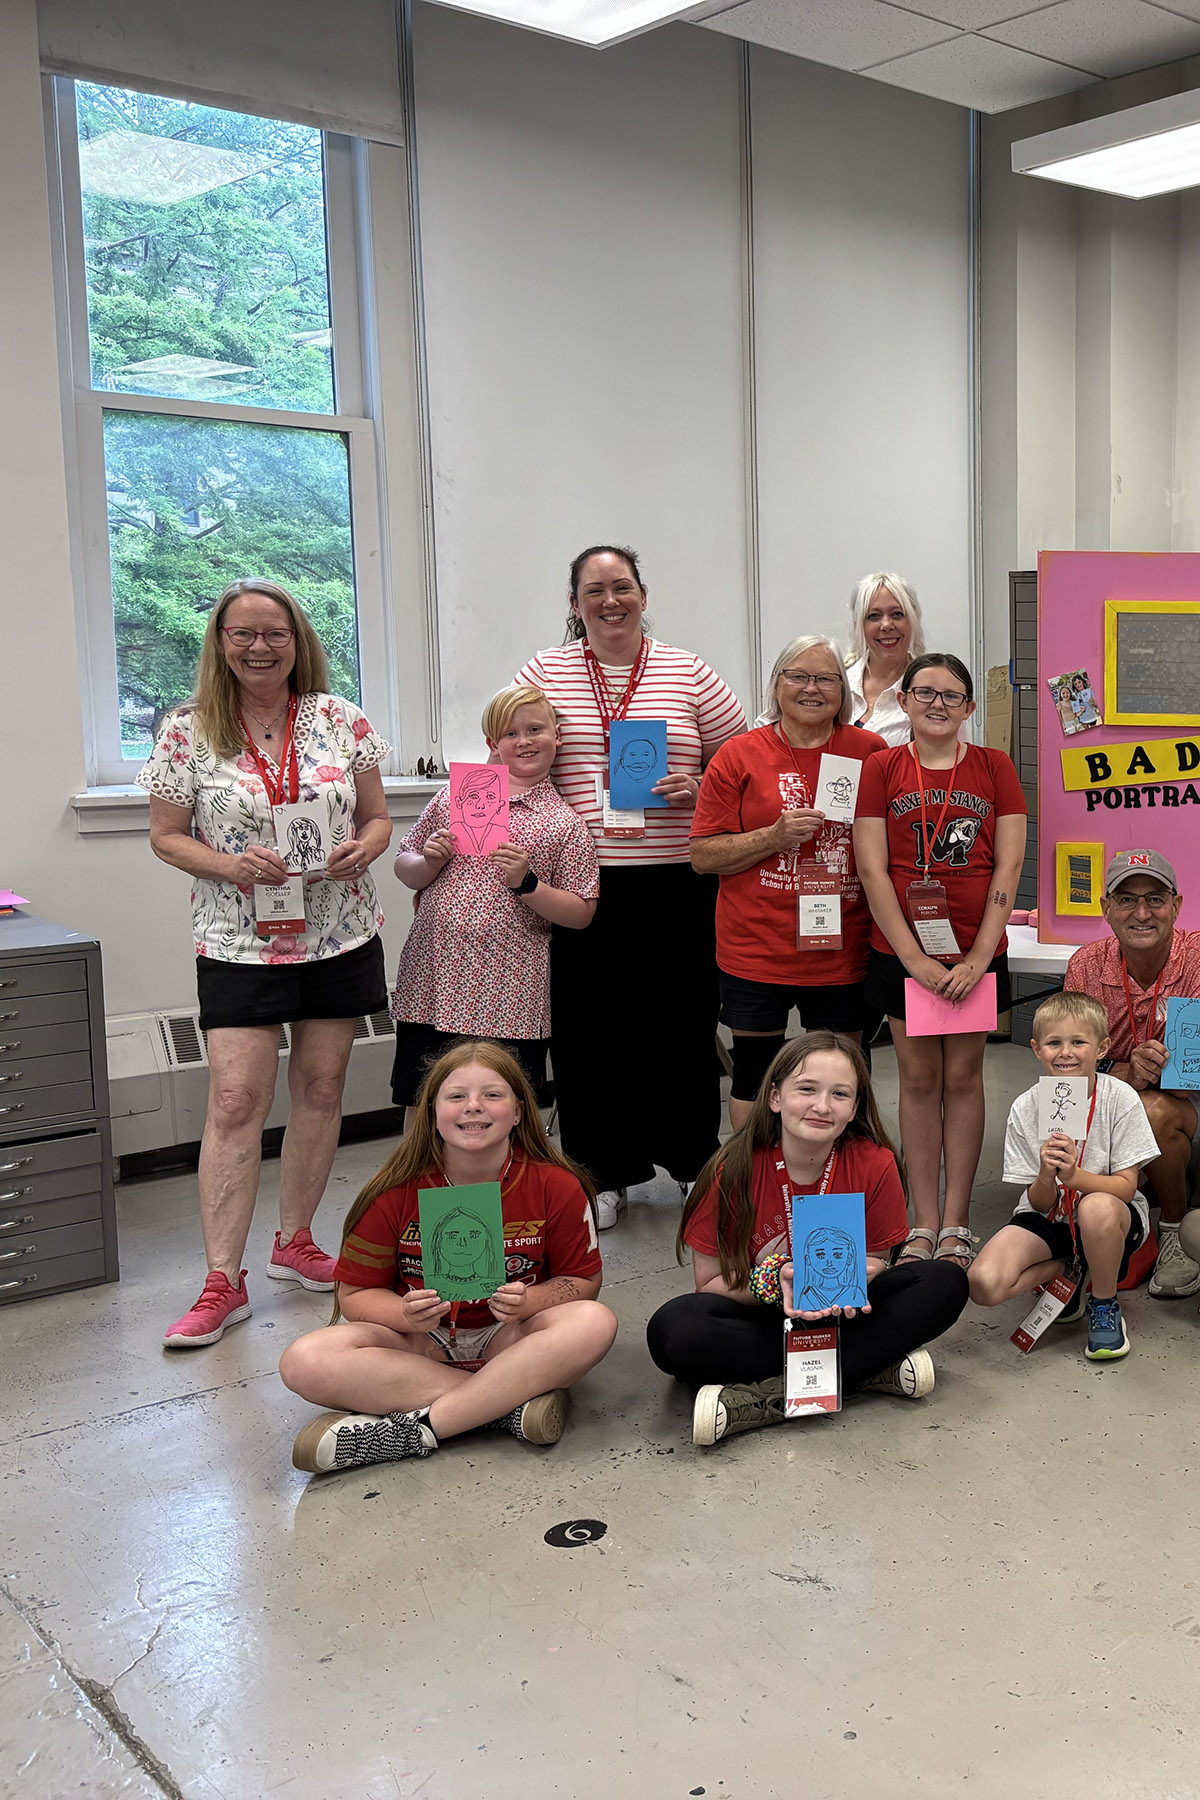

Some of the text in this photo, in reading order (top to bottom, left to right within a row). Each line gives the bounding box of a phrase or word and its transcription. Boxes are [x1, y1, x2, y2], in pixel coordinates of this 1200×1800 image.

[1085, 741, 1200, 783] BAD
[1128, 854, 1150, 866] N
[760, 869, 792, 882] University
[760, 878, 783, 890] School
[776, 1160, 785, 1171] N
[782, 1183, 791, 1212] University
[503, 1220, 546, 1239] ES
[583, 1200, 598, 1254] 1
[514, 1236, 543, 1247] SPORT
[564, 1523, 592, 1541] 6
